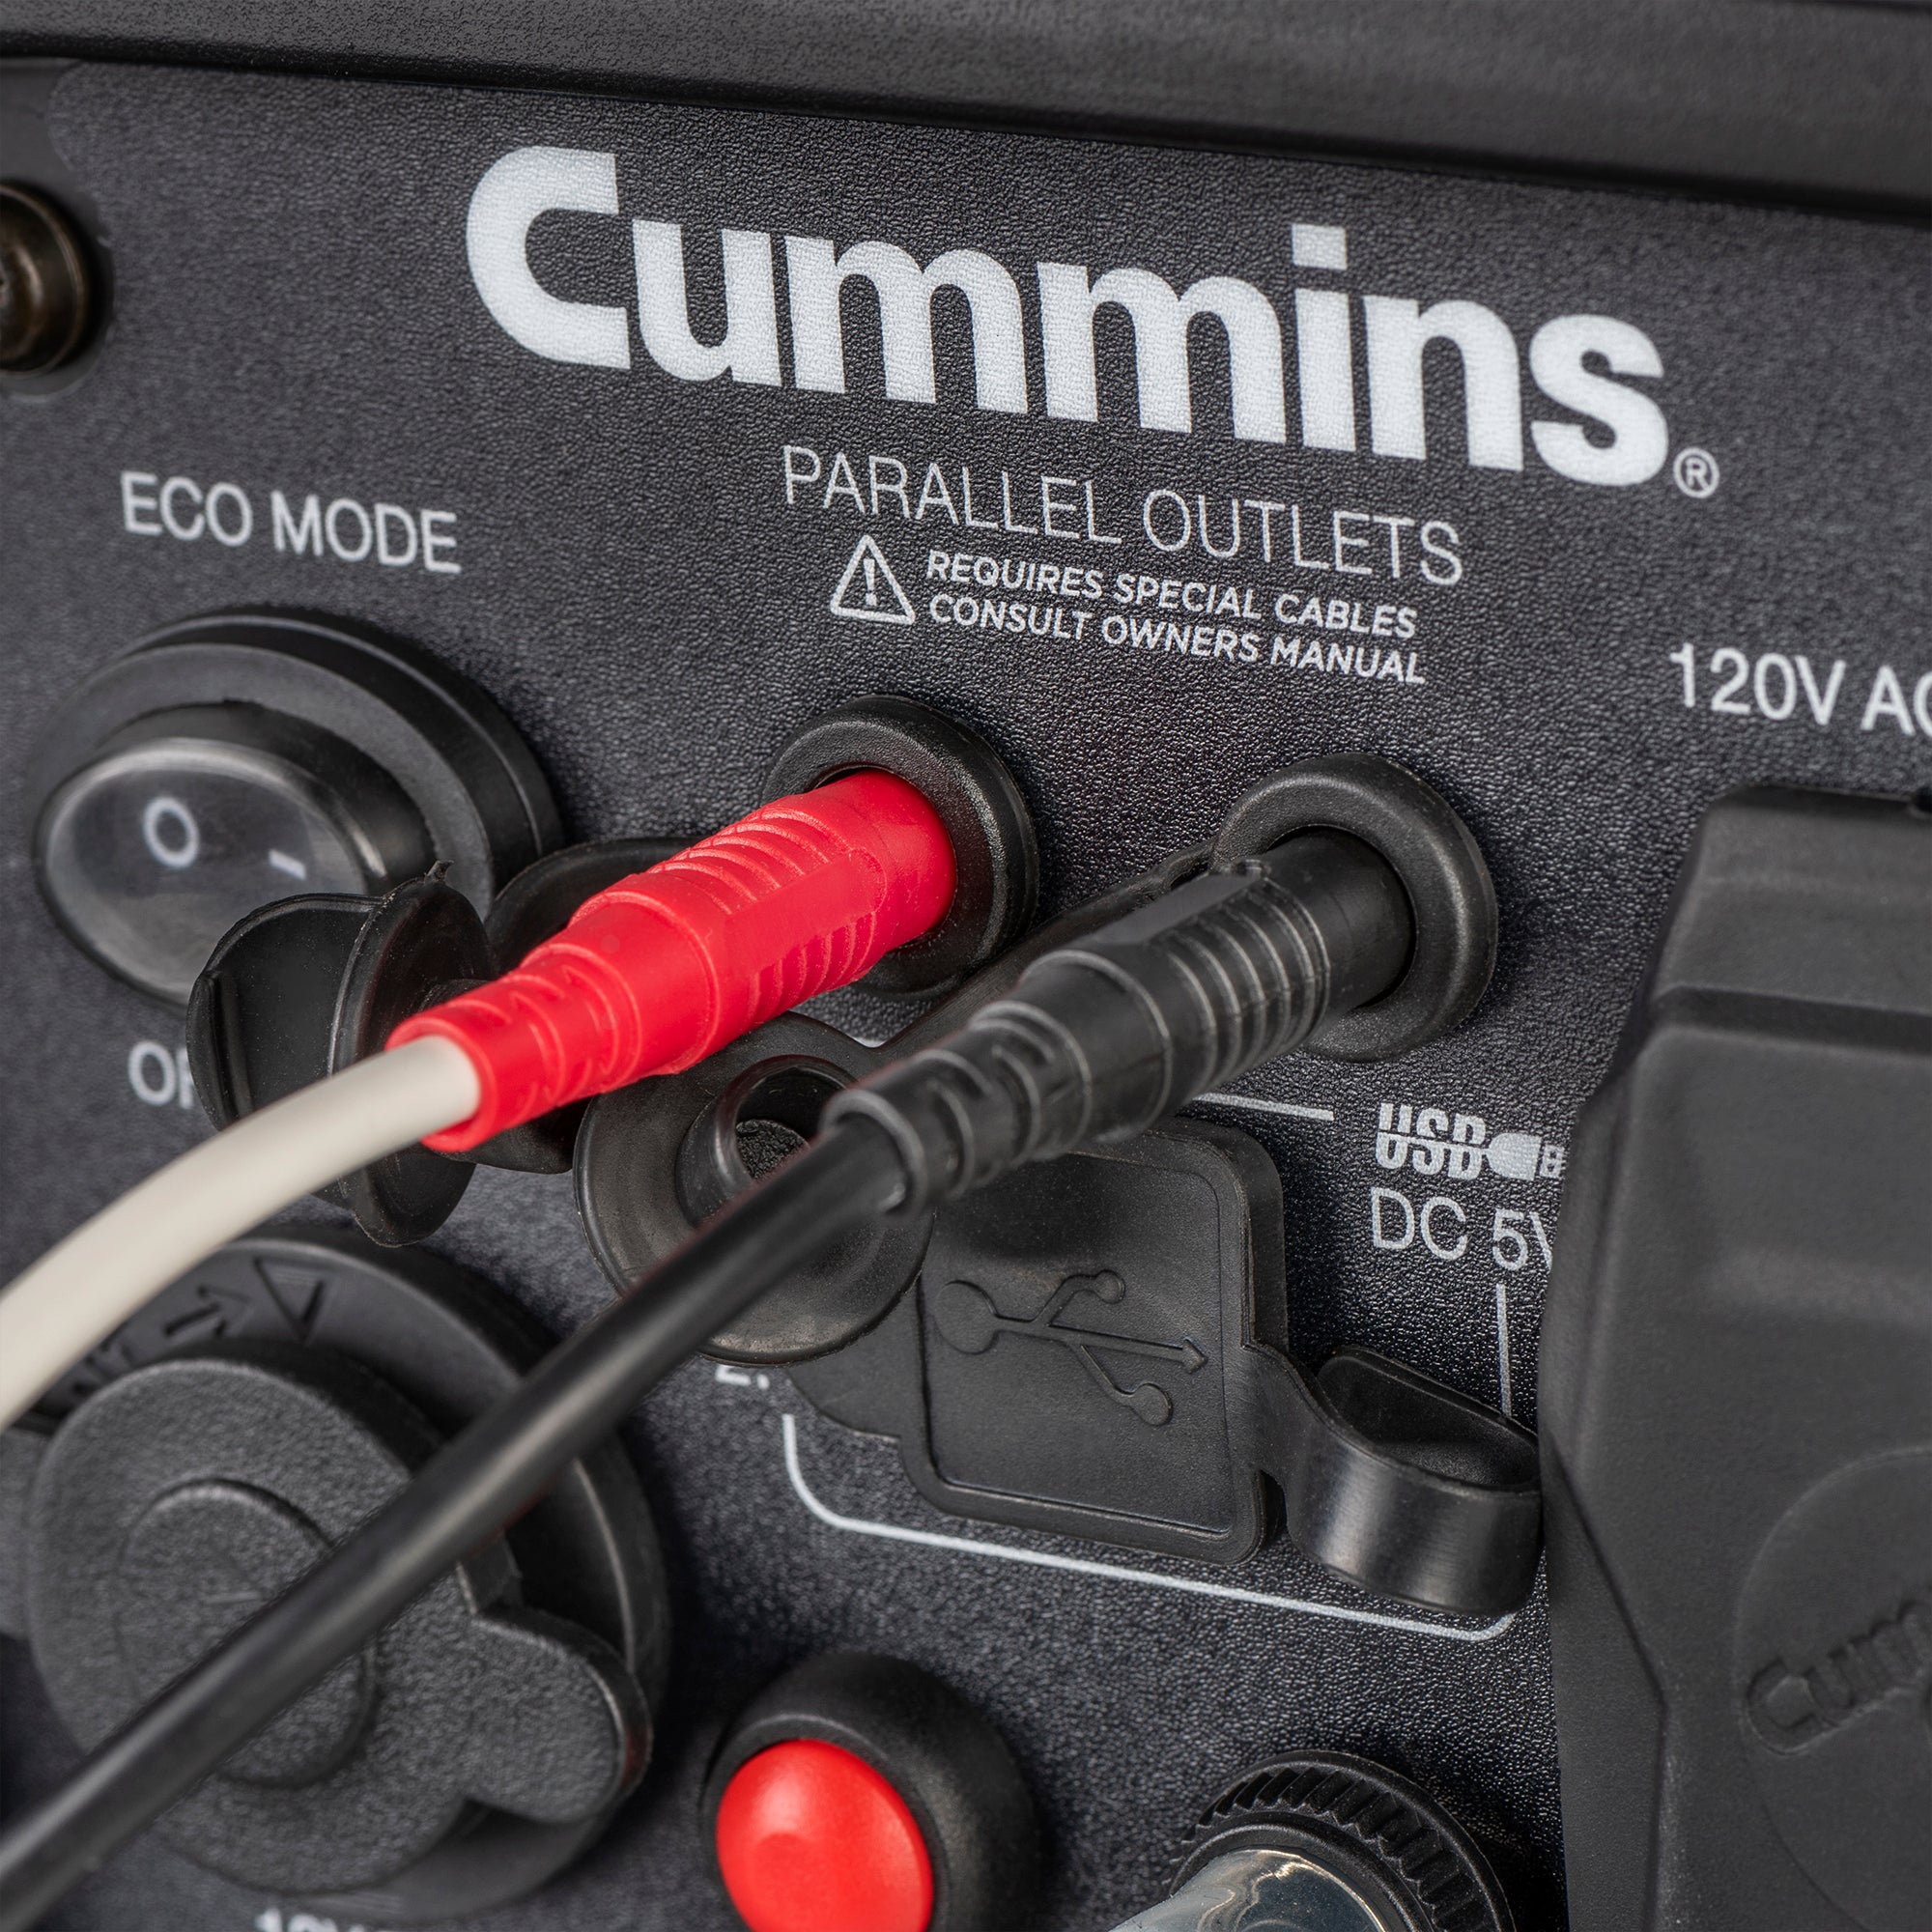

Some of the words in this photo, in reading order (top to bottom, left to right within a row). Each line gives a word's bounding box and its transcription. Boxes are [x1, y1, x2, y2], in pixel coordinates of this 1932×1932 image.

[121, 470, 253, 547] ECO
[270, 489, 462, 574] MODE
[782, 444, 1122, 544] PARALLEL
[1143, 488, 1463, 585] OUTLETS
[926, 549, 1104, 599] REQUIRES
[1112, 572, 1262, 619] SPECIAL
[1274, 593, 1418, 639] CABLES
[929, 593, 1093, 639] CONSULT
[1101, 614, 1261, 663] OWNERS
[1269, 637, 1426, 684] MANUAL
[1669, 642, 1846, 725] 120V
[1375, 1102, 1487, 1181] USB
[1371, 1186, 1469, 1261] DC
